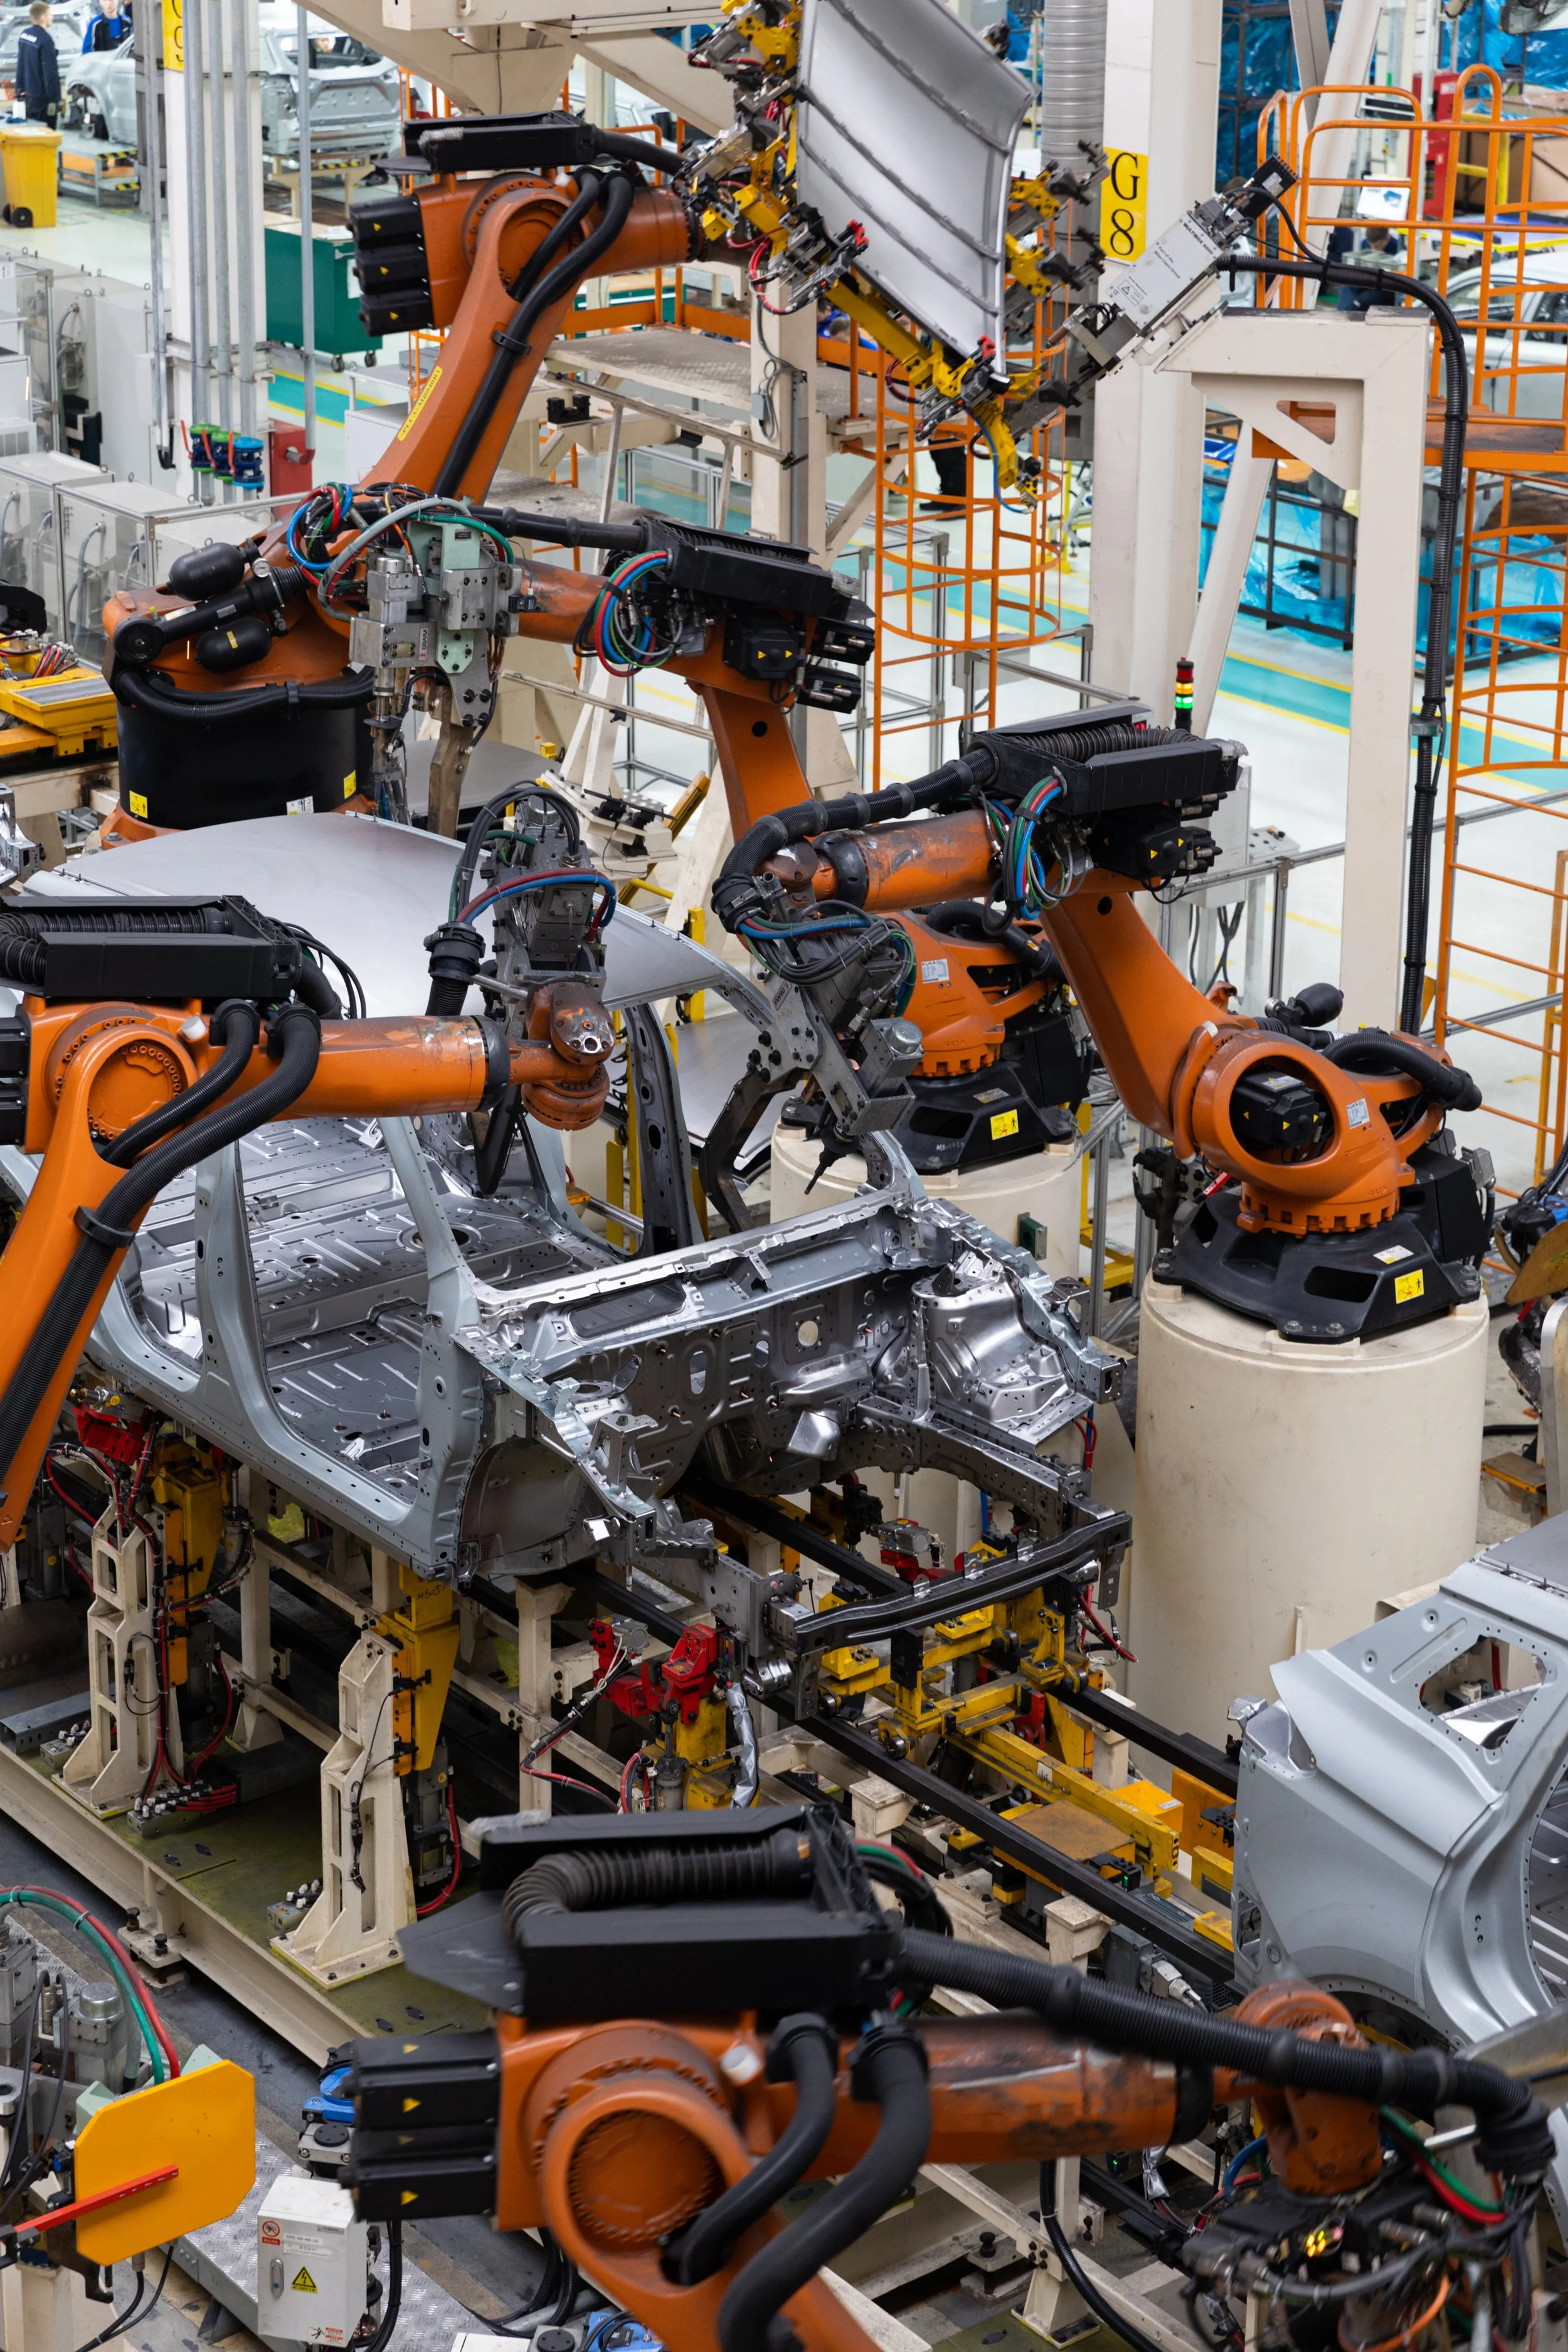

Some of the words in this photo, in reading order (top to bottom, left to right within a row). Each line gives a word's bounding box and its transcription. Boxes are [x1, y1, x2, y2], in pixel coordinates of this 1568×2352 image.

[1111, 152, 1140, 201] G
[1110, 208, 1135, 256] 8
[1183, 223, 1203, 244] MULTIBOX
[1202, 243, 1214, 255] 6000
[773, 987, 785, 1005] OBARA
